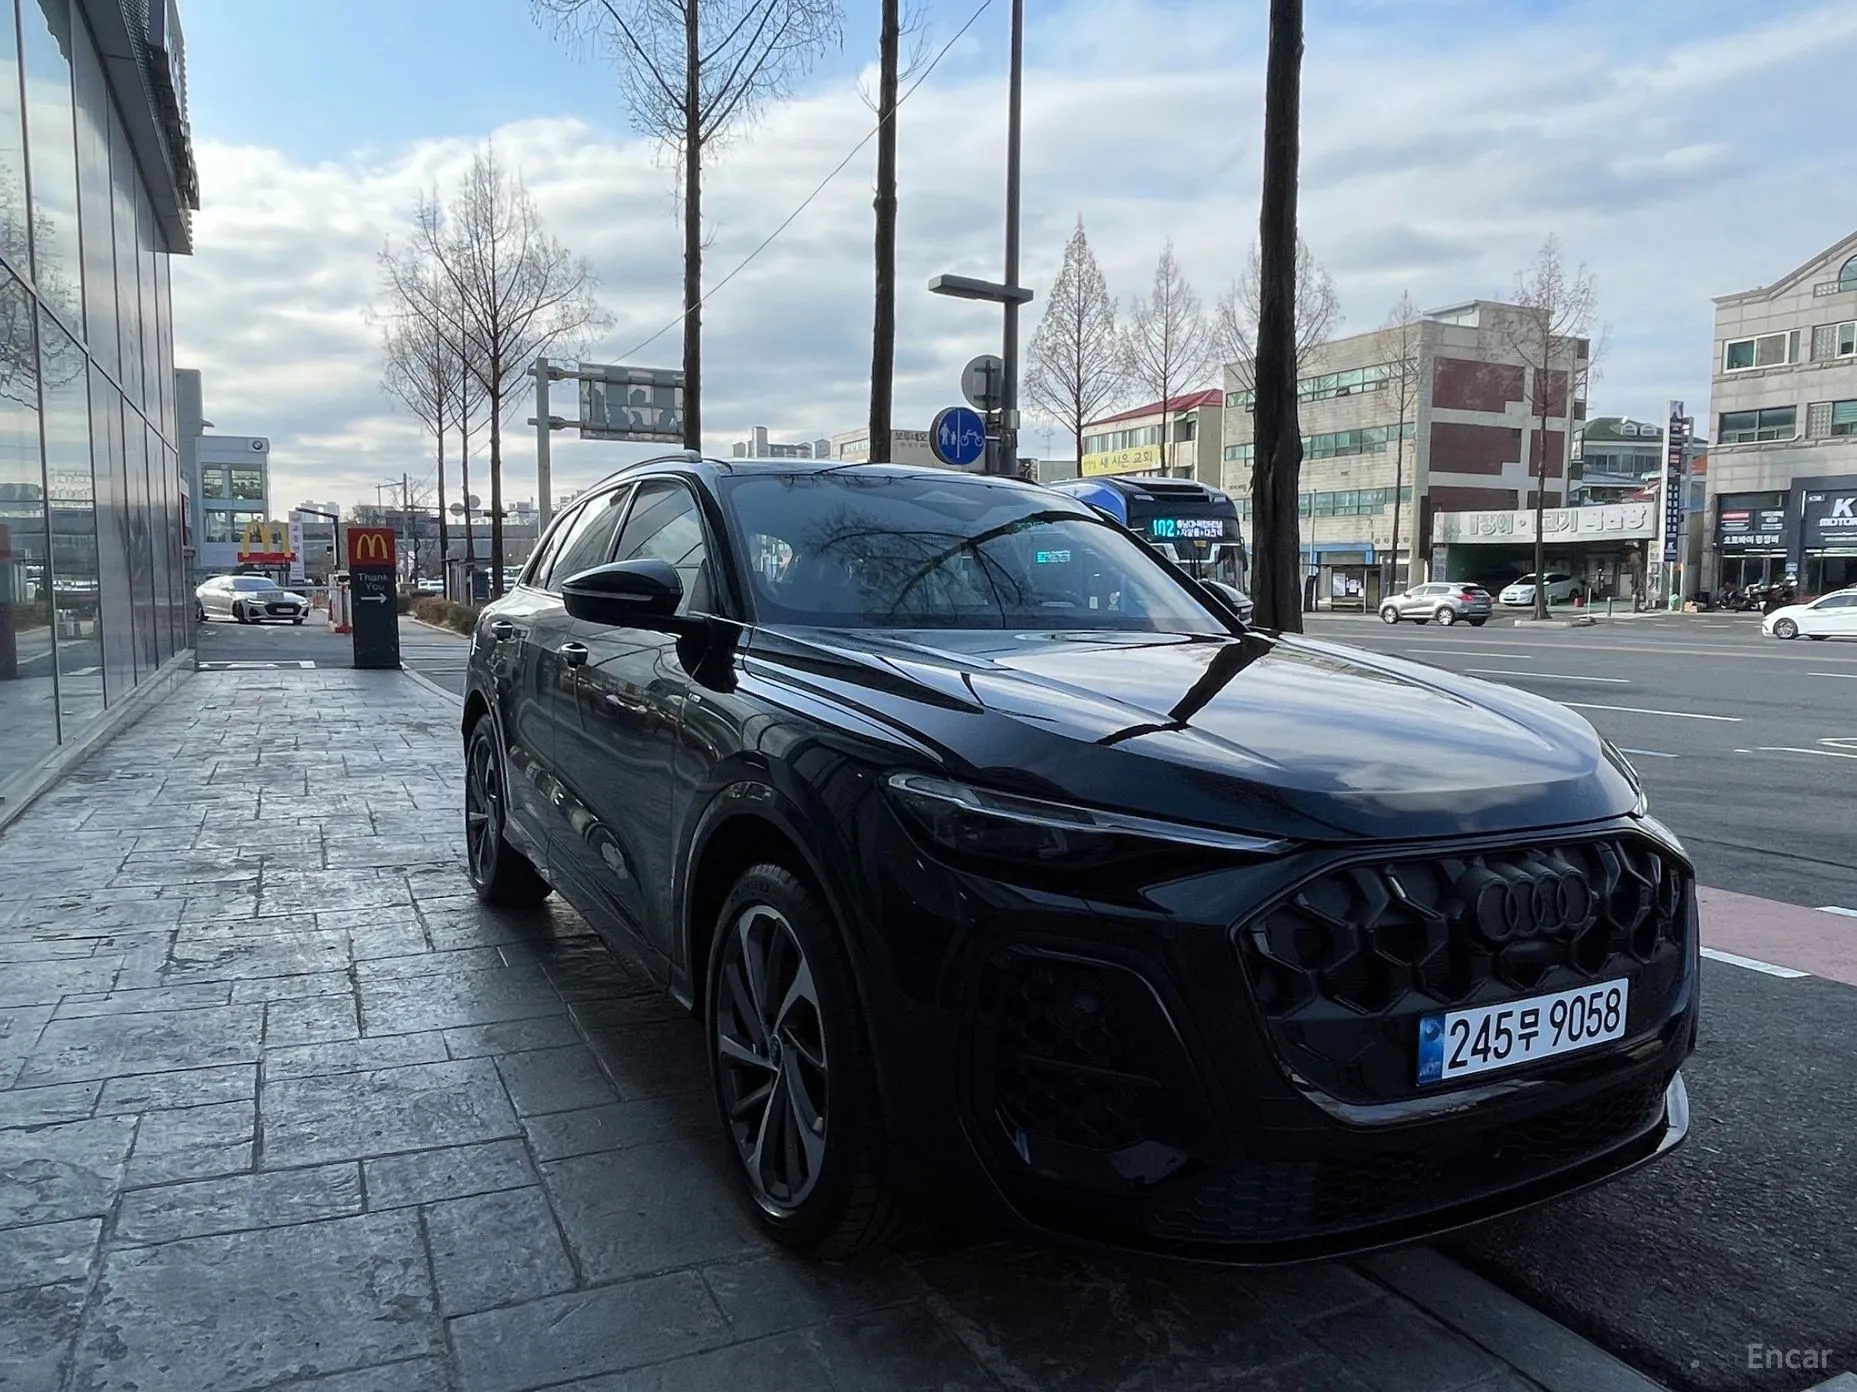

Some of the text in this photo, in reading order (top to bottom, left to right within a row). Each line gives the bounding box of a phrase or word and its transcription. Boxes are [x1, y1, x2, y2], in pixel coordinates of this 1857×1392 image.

[1132, 450, 1153, 464] 교회
[1832, 497, 1857, 517] K
[1153, 519, 1175, 537] 102
[357, 572, 389, 582] Thank
[365, 582, 385, 591] You
[1447, 987, 1622, 1070] 245무 9058
